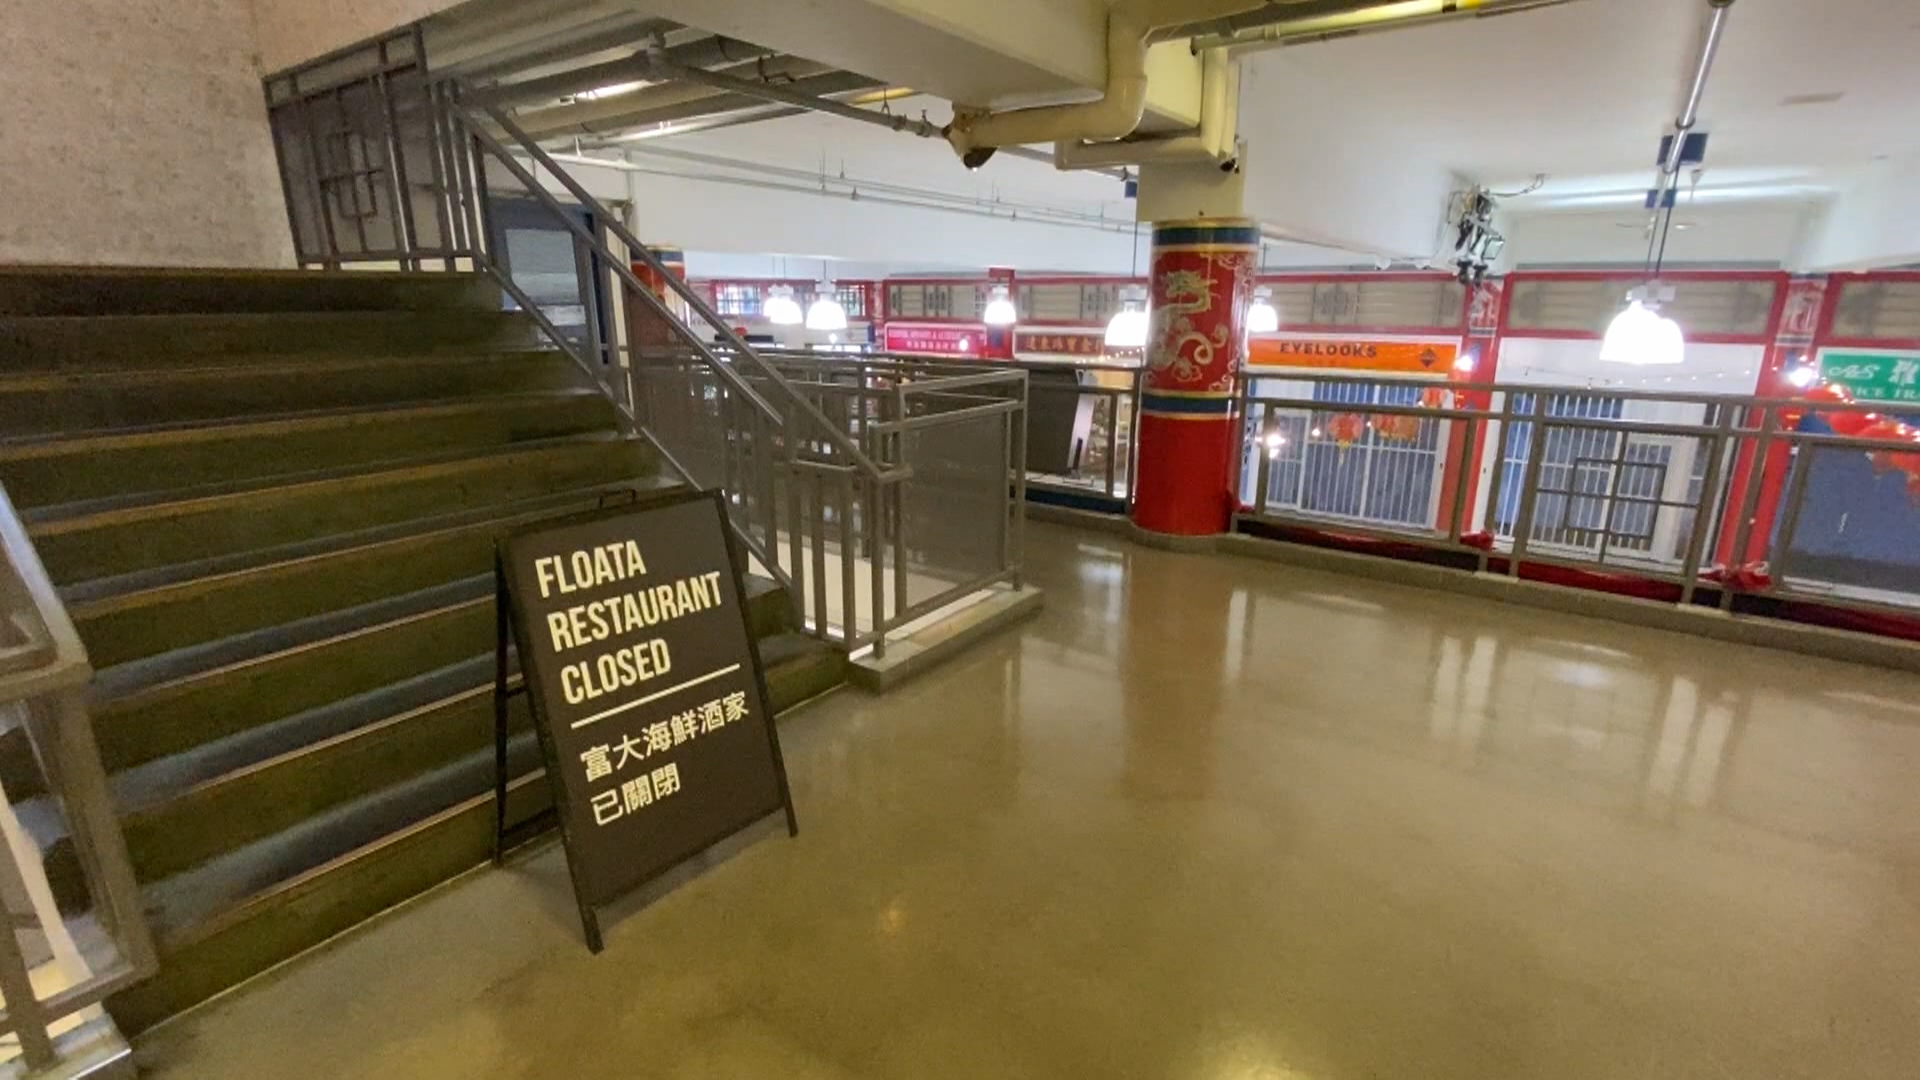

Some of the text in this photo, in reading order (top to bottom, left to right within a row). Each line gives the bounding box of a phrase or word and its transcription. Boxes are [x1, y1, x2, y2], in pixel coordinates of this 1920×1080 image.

[1279, 342, 1377, 358] EYELOOKS
[535, 539, 647, 598] FLOATA
[547, 571, 722, 652] RESTAURANT
[560, 638, 671, 705] CLOSED
[580, 691, 749, 782] 富大海鮮酒家
[590, 762, 681, 826] 已關閉
